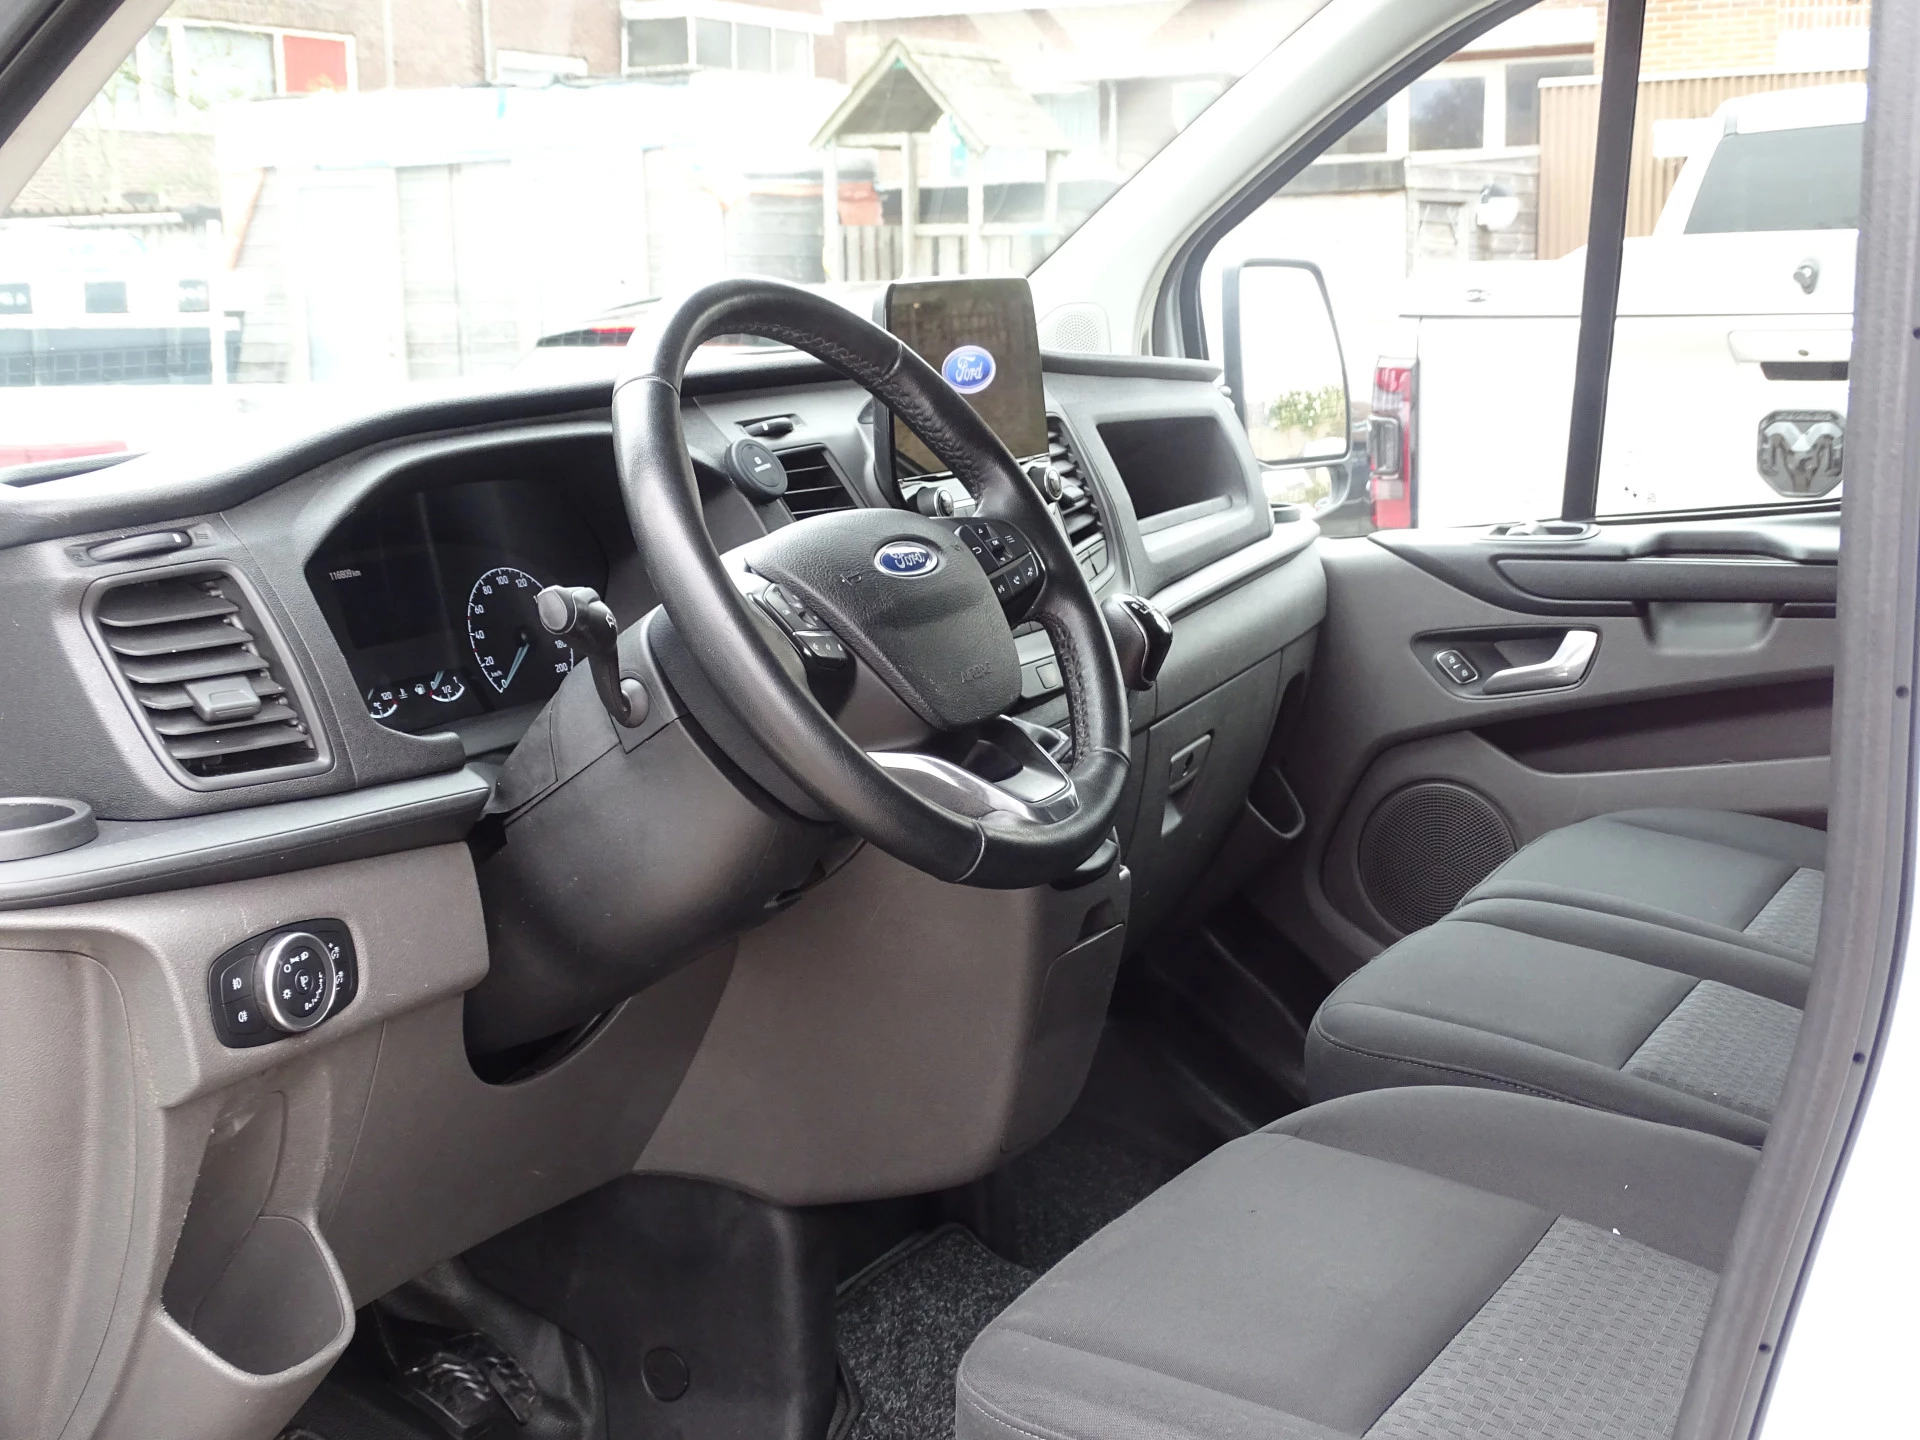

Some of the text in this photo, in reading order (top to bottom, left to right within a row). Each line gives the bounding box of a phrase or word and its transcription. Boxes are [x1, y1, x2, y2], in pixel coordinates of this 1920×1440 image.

[956, 356, 983, 382] Ford
[889, 550, 925, 569] Ford
[496, 576, 509, 585] 100
[515, 578, 528, 588] 120
[482, 585, 493, 595] 80
[474, 604, 485, 614] 60
[475, 630, 485, 640] 40
[484, 656, 495, 666] 20
[555, 662, 568, 673] 200
